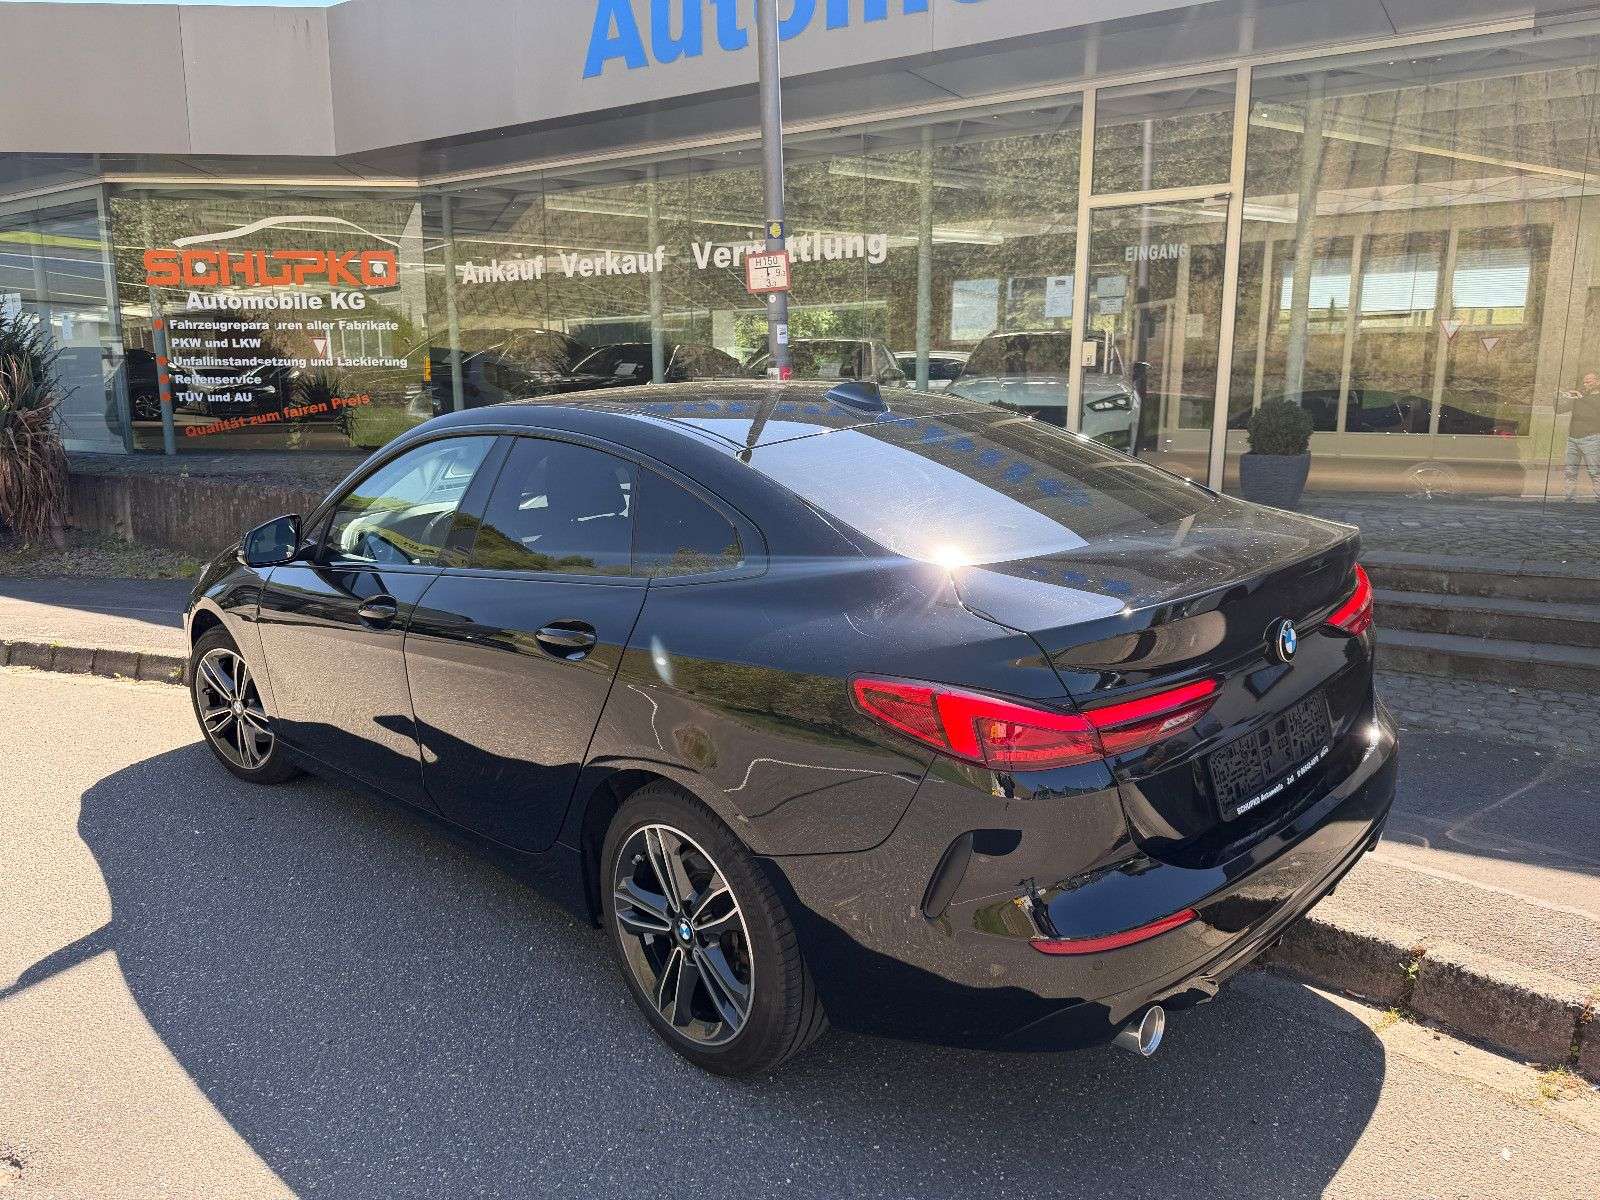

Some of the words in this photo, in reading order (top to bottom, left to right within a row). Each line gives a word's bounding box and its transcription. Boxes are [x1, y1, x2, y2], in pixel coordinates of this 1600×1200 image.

[462, 255, 545, 285] Ankauf
[559, 245, 666, 278] Verkauf
[691, 232, 888, 270] Verttlung
[1125, 244, 1189, 262] EINGANG
[144, 250, 398, 287] SCHUPKO
[186, 291, 323, 310] Automobile
[331, 291, 366, 310] KG
[169, 319, 303, 333] Fahrzeugreparauren
[306, 320, 335, 330] aller
[338, 321, 399, 331] Fabrikate
[172, 338, 202, 348] PKW
[204, 338, 229, 348] und
[232, 338, 261, 348] LKW
[172, 356, 307, 369] Unfallinstandsetzung
[310, 356, 333, 367] und
[337, 357, 408, 369] Lackierung
[175, 374, 262, 384] Reifenservice
[176, 391, 204, 401] TÜV
[207, 391, 231, 402] und
[233, 392, 253, 402] AU
[184, 416, 250, 437] Qualität
[249, 412, 281, 426] zum
[283, 401, 328, 419] fairen
[331, 393, 371, 410] Preis
